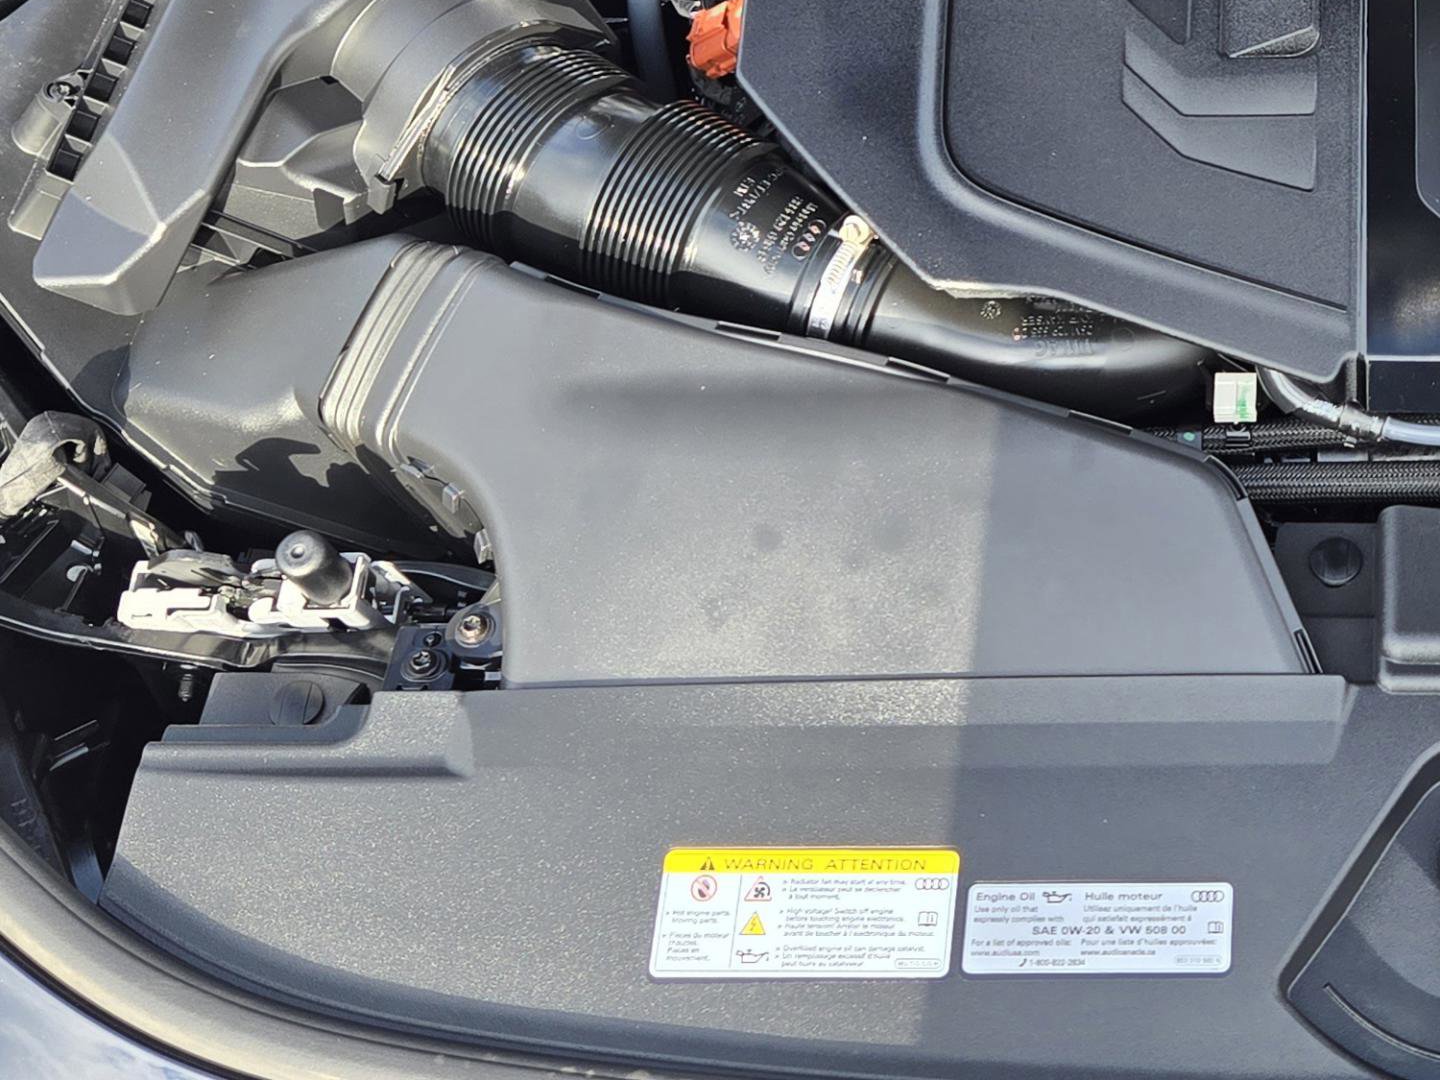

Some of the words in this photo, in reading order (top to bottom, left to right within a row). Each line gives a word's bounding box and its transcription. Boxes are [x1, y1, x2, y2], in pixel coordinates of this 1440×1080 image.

[723, 858, 813, 871] WARNING
[824, 858, 927, 871] ATTENTION
[976, 892, 1016, 903] Engine
[1019, 892, 1036, 902] Oil
[1084, 891, 1114, 901] Huile
[1117, 892, 1163, 901] moteur
[1031, 926, 1058, 936] SAE
[1061, 925, 1101, 935] 0W-20
[1104, 926, 1114, 935] &
[1119, 925, 1142, 935] VW
[1171, 925, 1187, 935] 00
